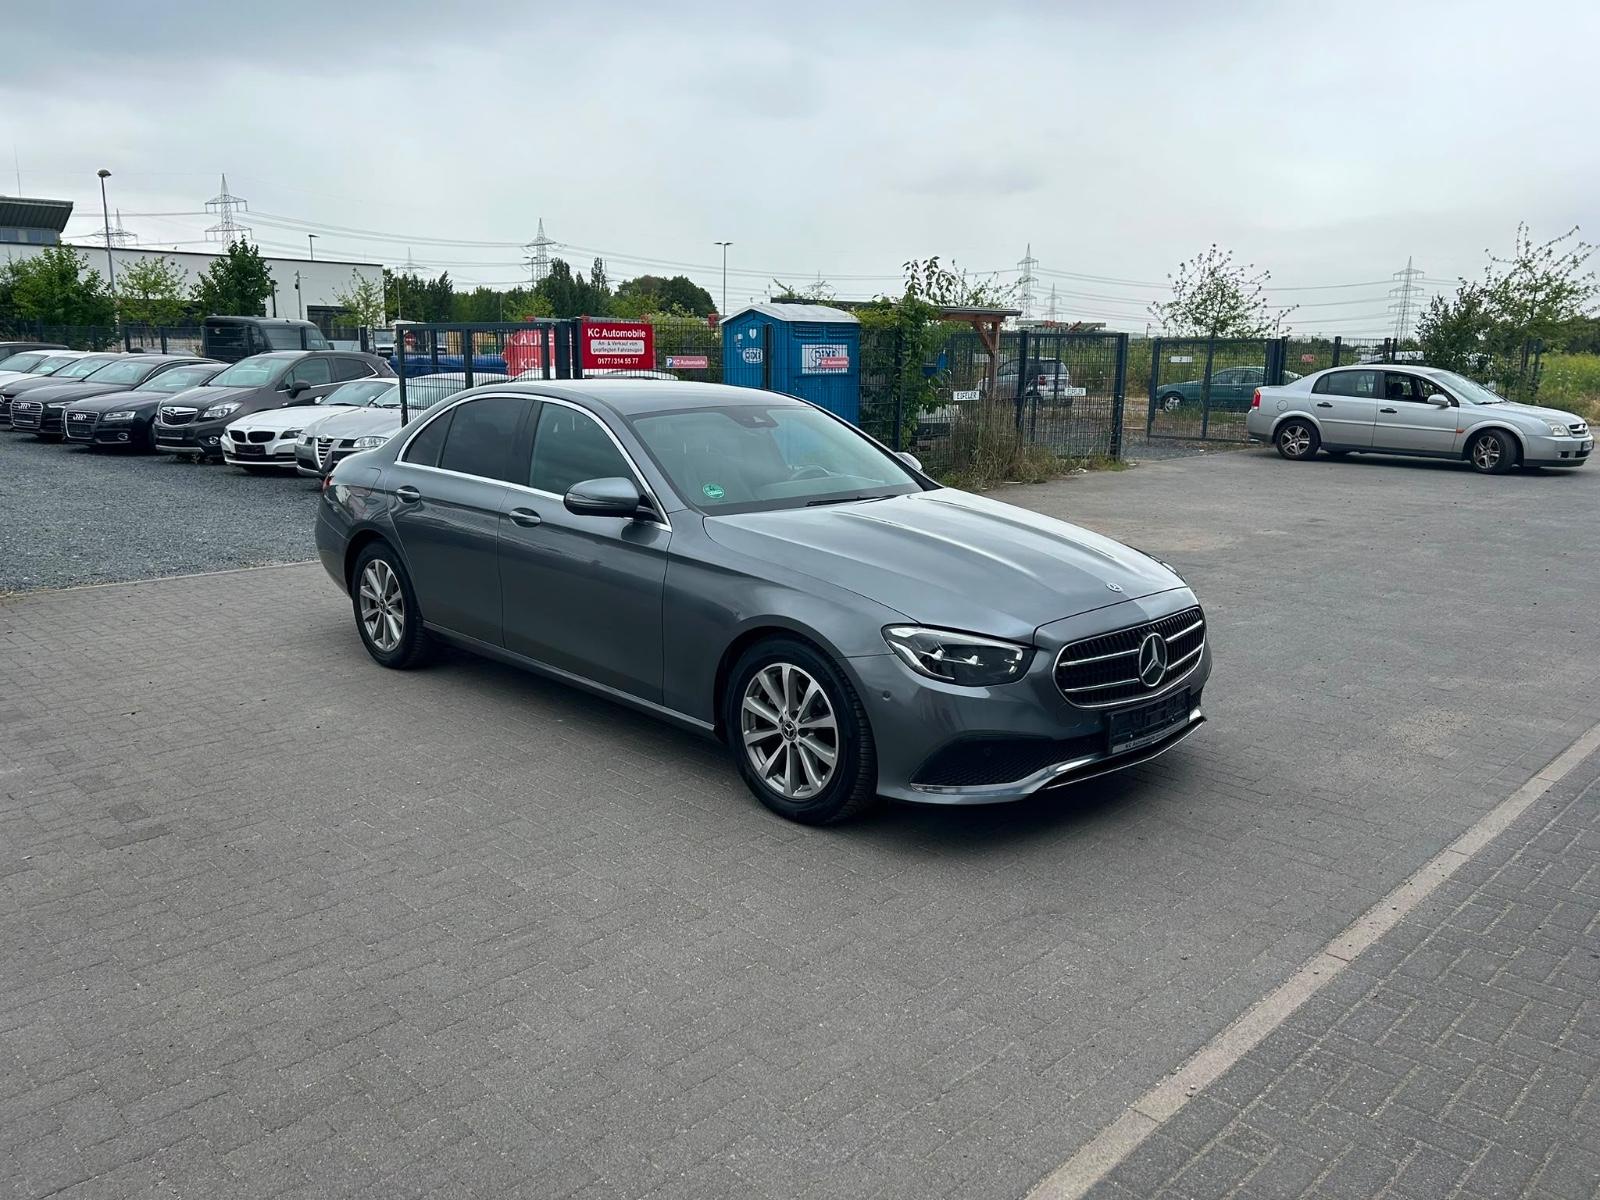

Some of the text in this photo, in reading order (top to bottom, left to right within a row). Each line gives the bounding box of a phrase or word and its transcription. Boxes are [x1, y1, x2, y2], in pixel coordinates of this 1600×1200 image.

[587, 328, 647, 338] KC Automobile
[625, 357, 631, 365] 55
[632, 357, 639, 365] 77
